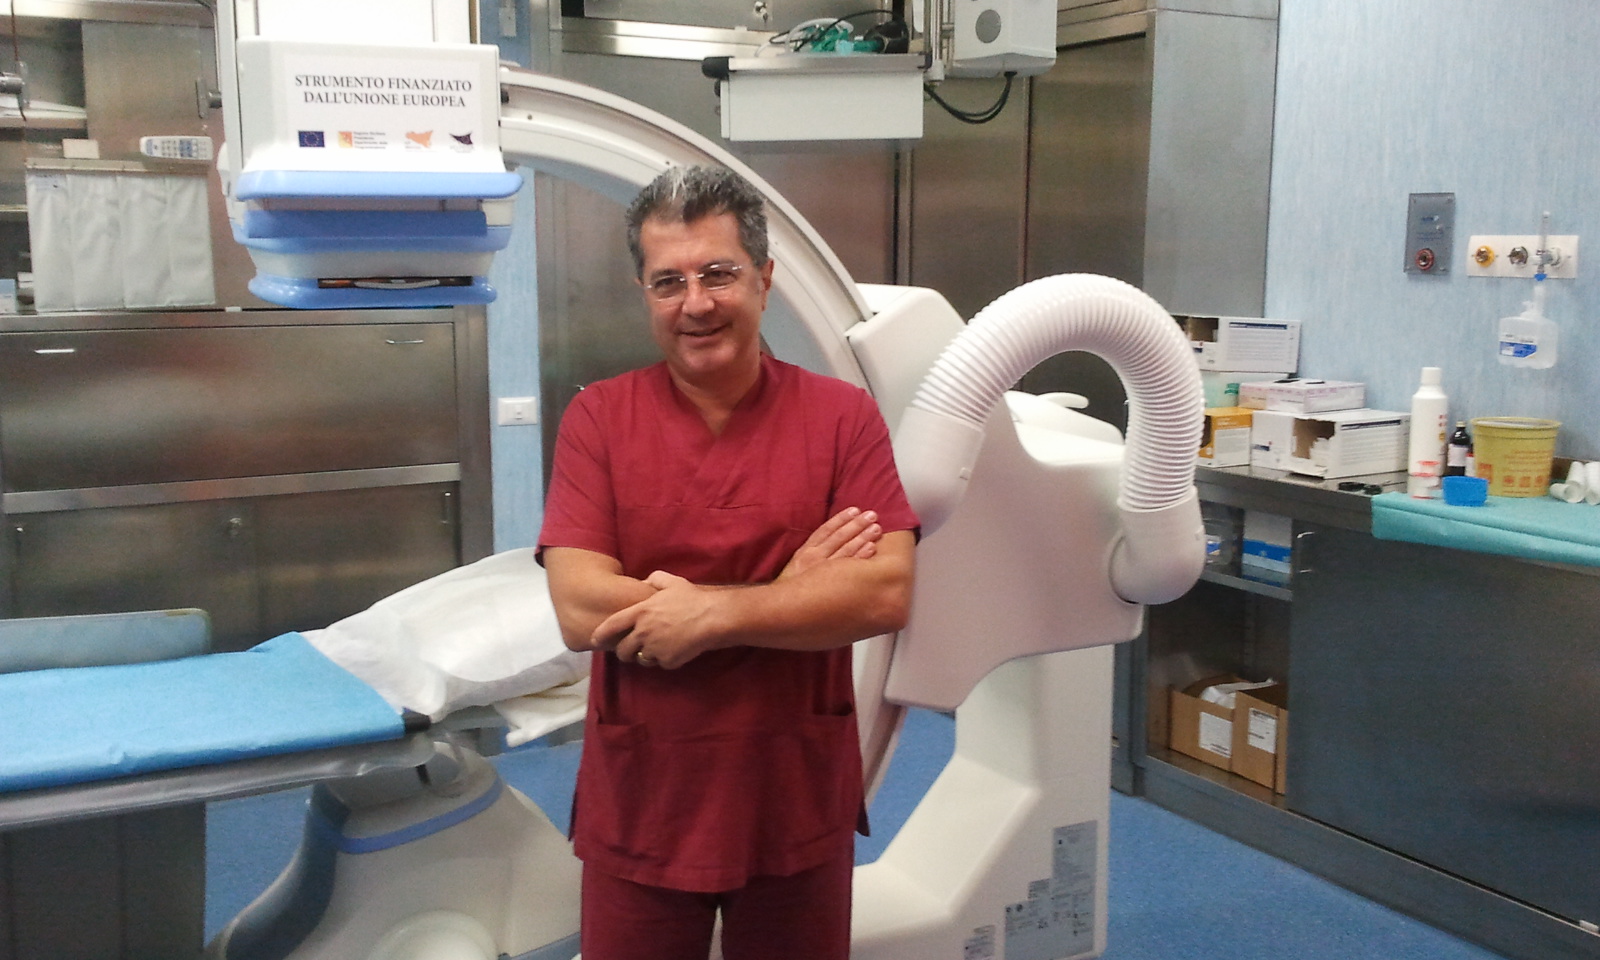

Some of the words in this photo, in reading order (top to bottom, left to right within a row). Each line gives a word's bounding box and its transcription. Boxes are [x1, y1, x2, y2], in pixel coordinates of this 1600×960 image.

[295, 74, 384, 89] STRUMENTO
[388, 77, 472, 92] FINANZIATO
[304, 91, 399, 105] DALL’UNIONE
[403, 95, 466, 108] EUROPEA
